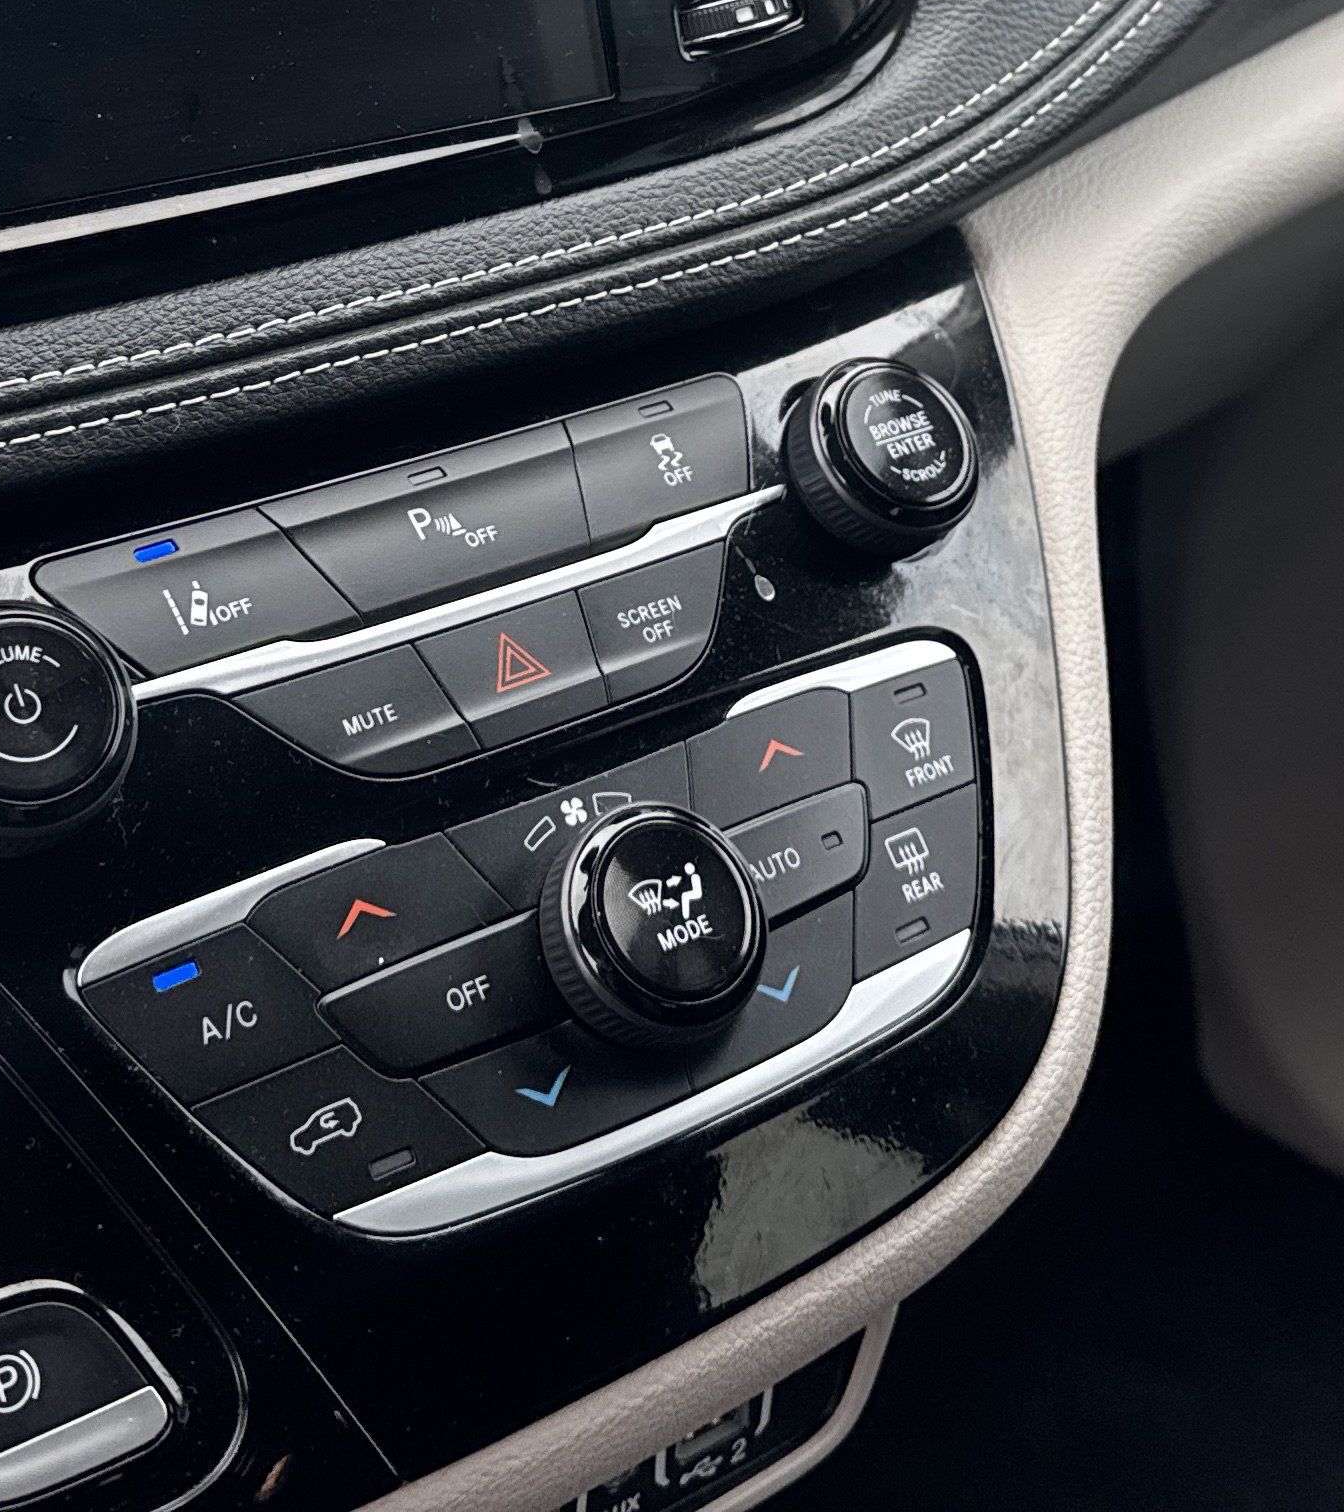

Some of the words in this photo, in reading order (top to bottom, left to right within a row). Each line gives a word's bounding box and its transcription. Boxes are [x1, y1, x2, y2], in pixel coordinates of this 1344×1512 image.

[868, 389, 903, 407] TUNE
[868, 410, 930, 441] BROWSE
[886, 432, 937, 460] ENTER
[663, 465, 694, 487] OFF
[901, 459, 947, 482] SCROLL
[464, 524, 499, 548] OFF
[215, 597, 253, 622] OFF
[617, 595, 683, 629] SCREEN
[642, 619, 674, 644] OFF
[341, 703, 400, 737] MUTE
[905, 754, 955, 788] FRONT
[748, 847, 801, 883] AUTO
[902, 871, 945, 904] REAR
[657, 913, 714, 952] MODE
[446, 974, 491, 1011] OFF
[202, 1000, 258, 1046] A/C
[730, 1438, 747, 1464] 2
